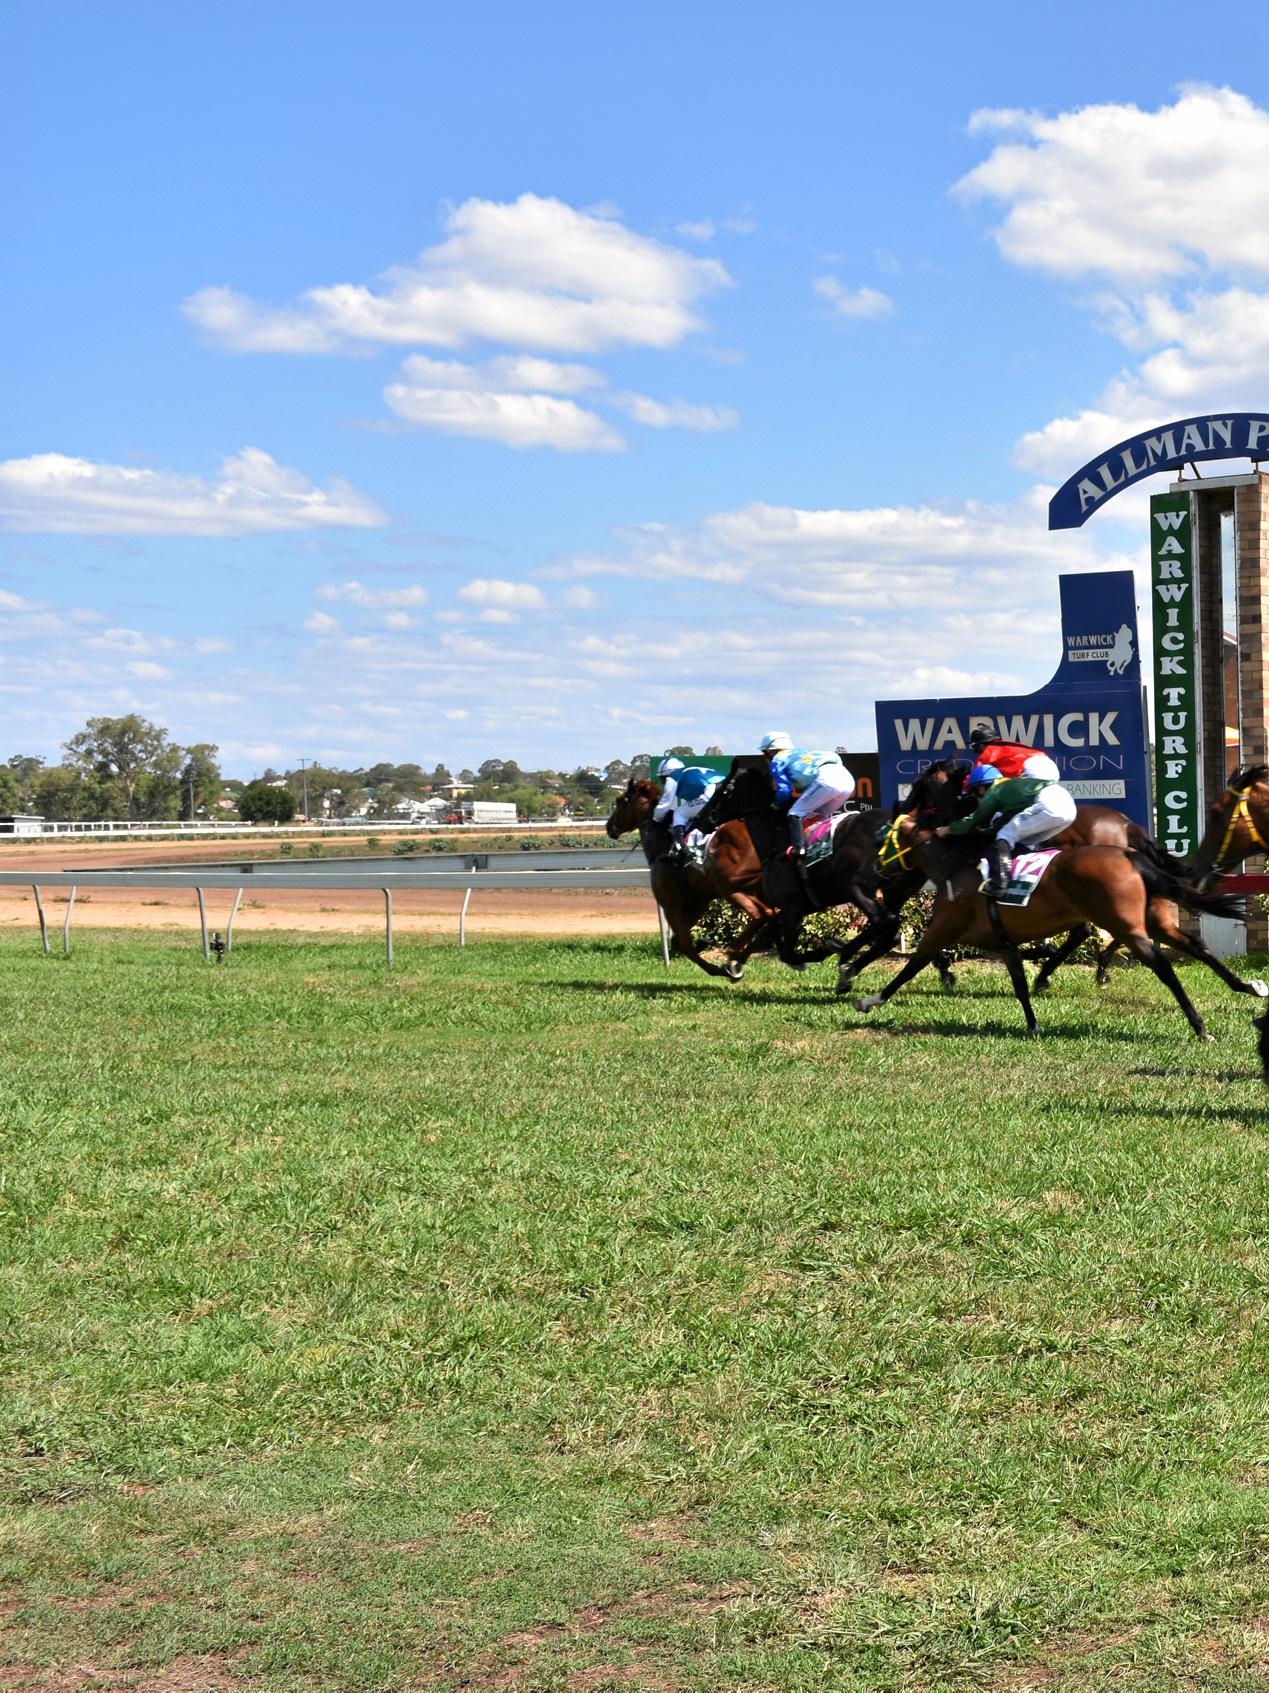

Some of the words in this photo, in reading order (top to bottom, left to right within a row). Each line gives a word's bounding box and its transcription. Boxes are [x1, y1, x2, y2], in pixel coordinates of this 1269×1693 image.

[1077, 419, 1235, 513] ALLMAN
[1153, 511, 1189, 676] WARWICK
[1066, 634, 1114, 647] WARWICK
[1072, 652, 1090, 660] TURF
[1091, 651, 1110, 659] CLUB
[1161, 687, 1188, 779] TURF
[1053, 754, 1124, 771] ION
[1066, 783, 1122, 796] BANKING
[1164, 791, 1191, 858] CLU
